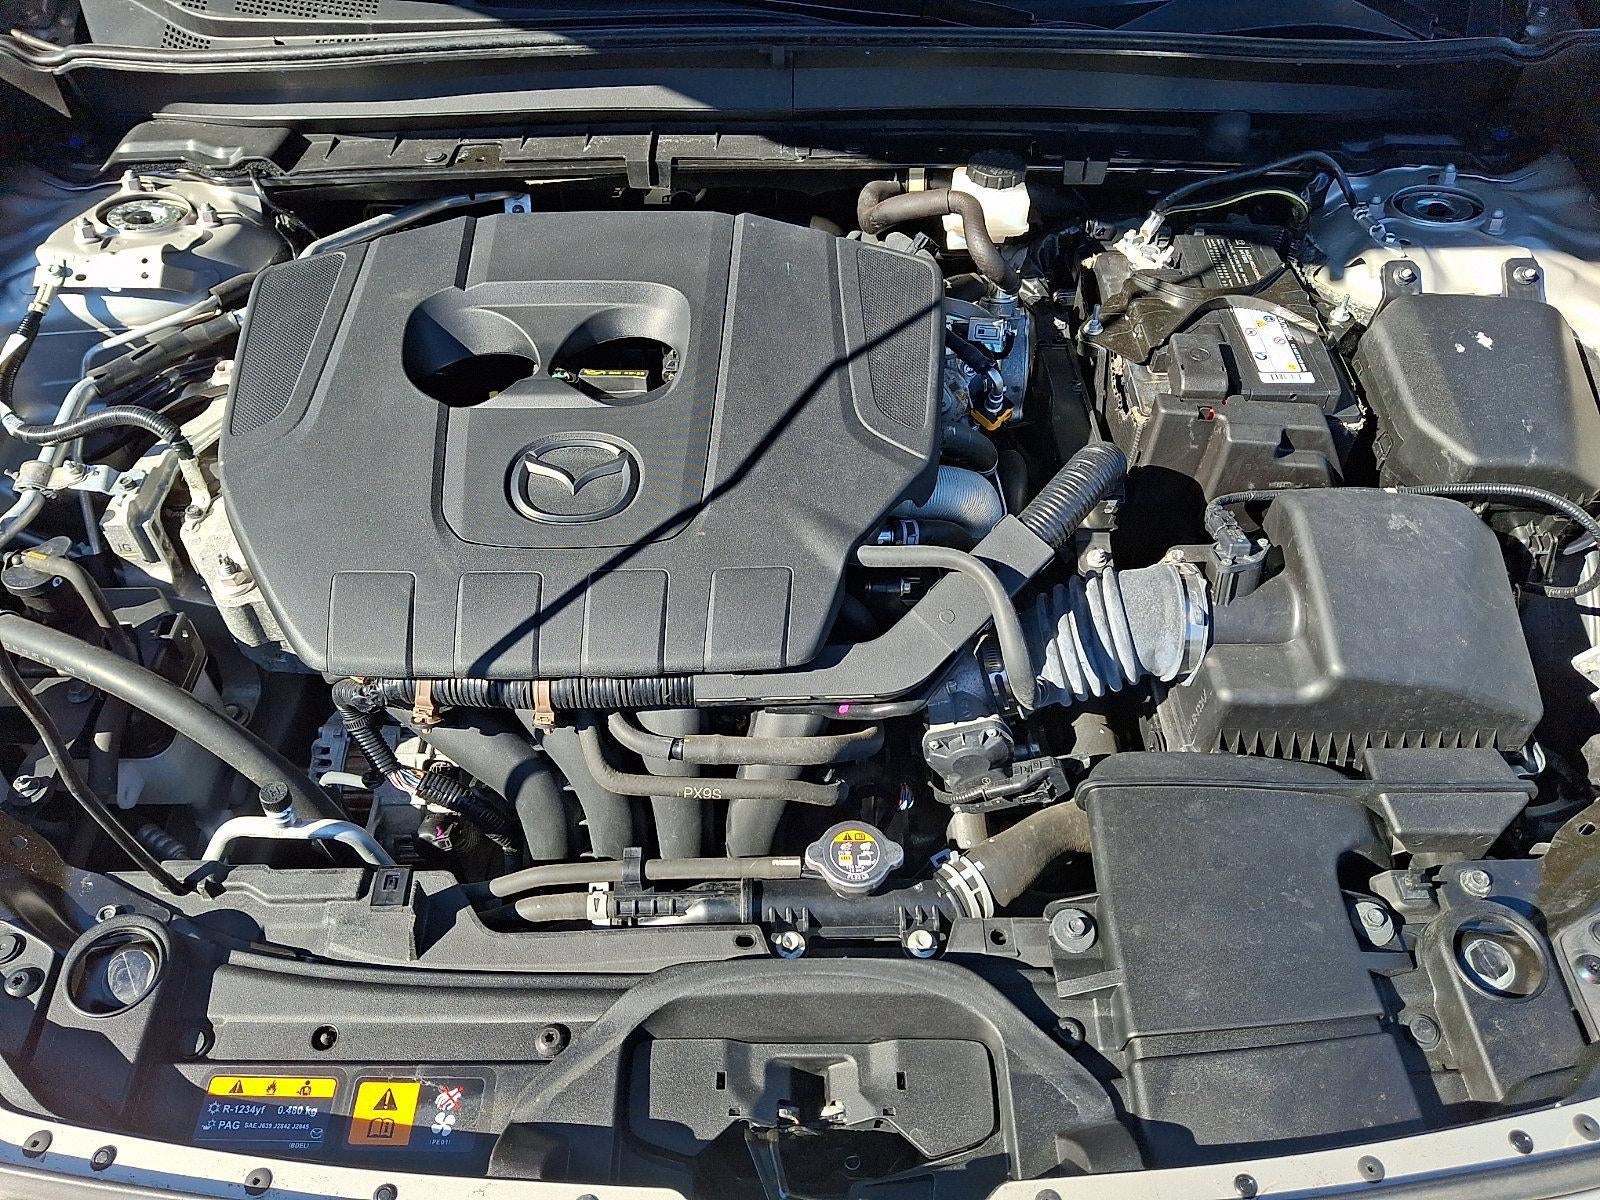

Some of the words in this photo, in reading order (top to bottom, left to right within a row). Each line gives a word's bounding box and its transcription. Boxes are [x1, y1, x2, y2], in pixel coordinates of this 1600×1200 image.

[683, 786, 722, 800] PX9S
[222, 1104, 266, 1115] R-1234yf
[304, 1105, 318, 1117] kg
[218, 1120, 241, 1130] PAG
